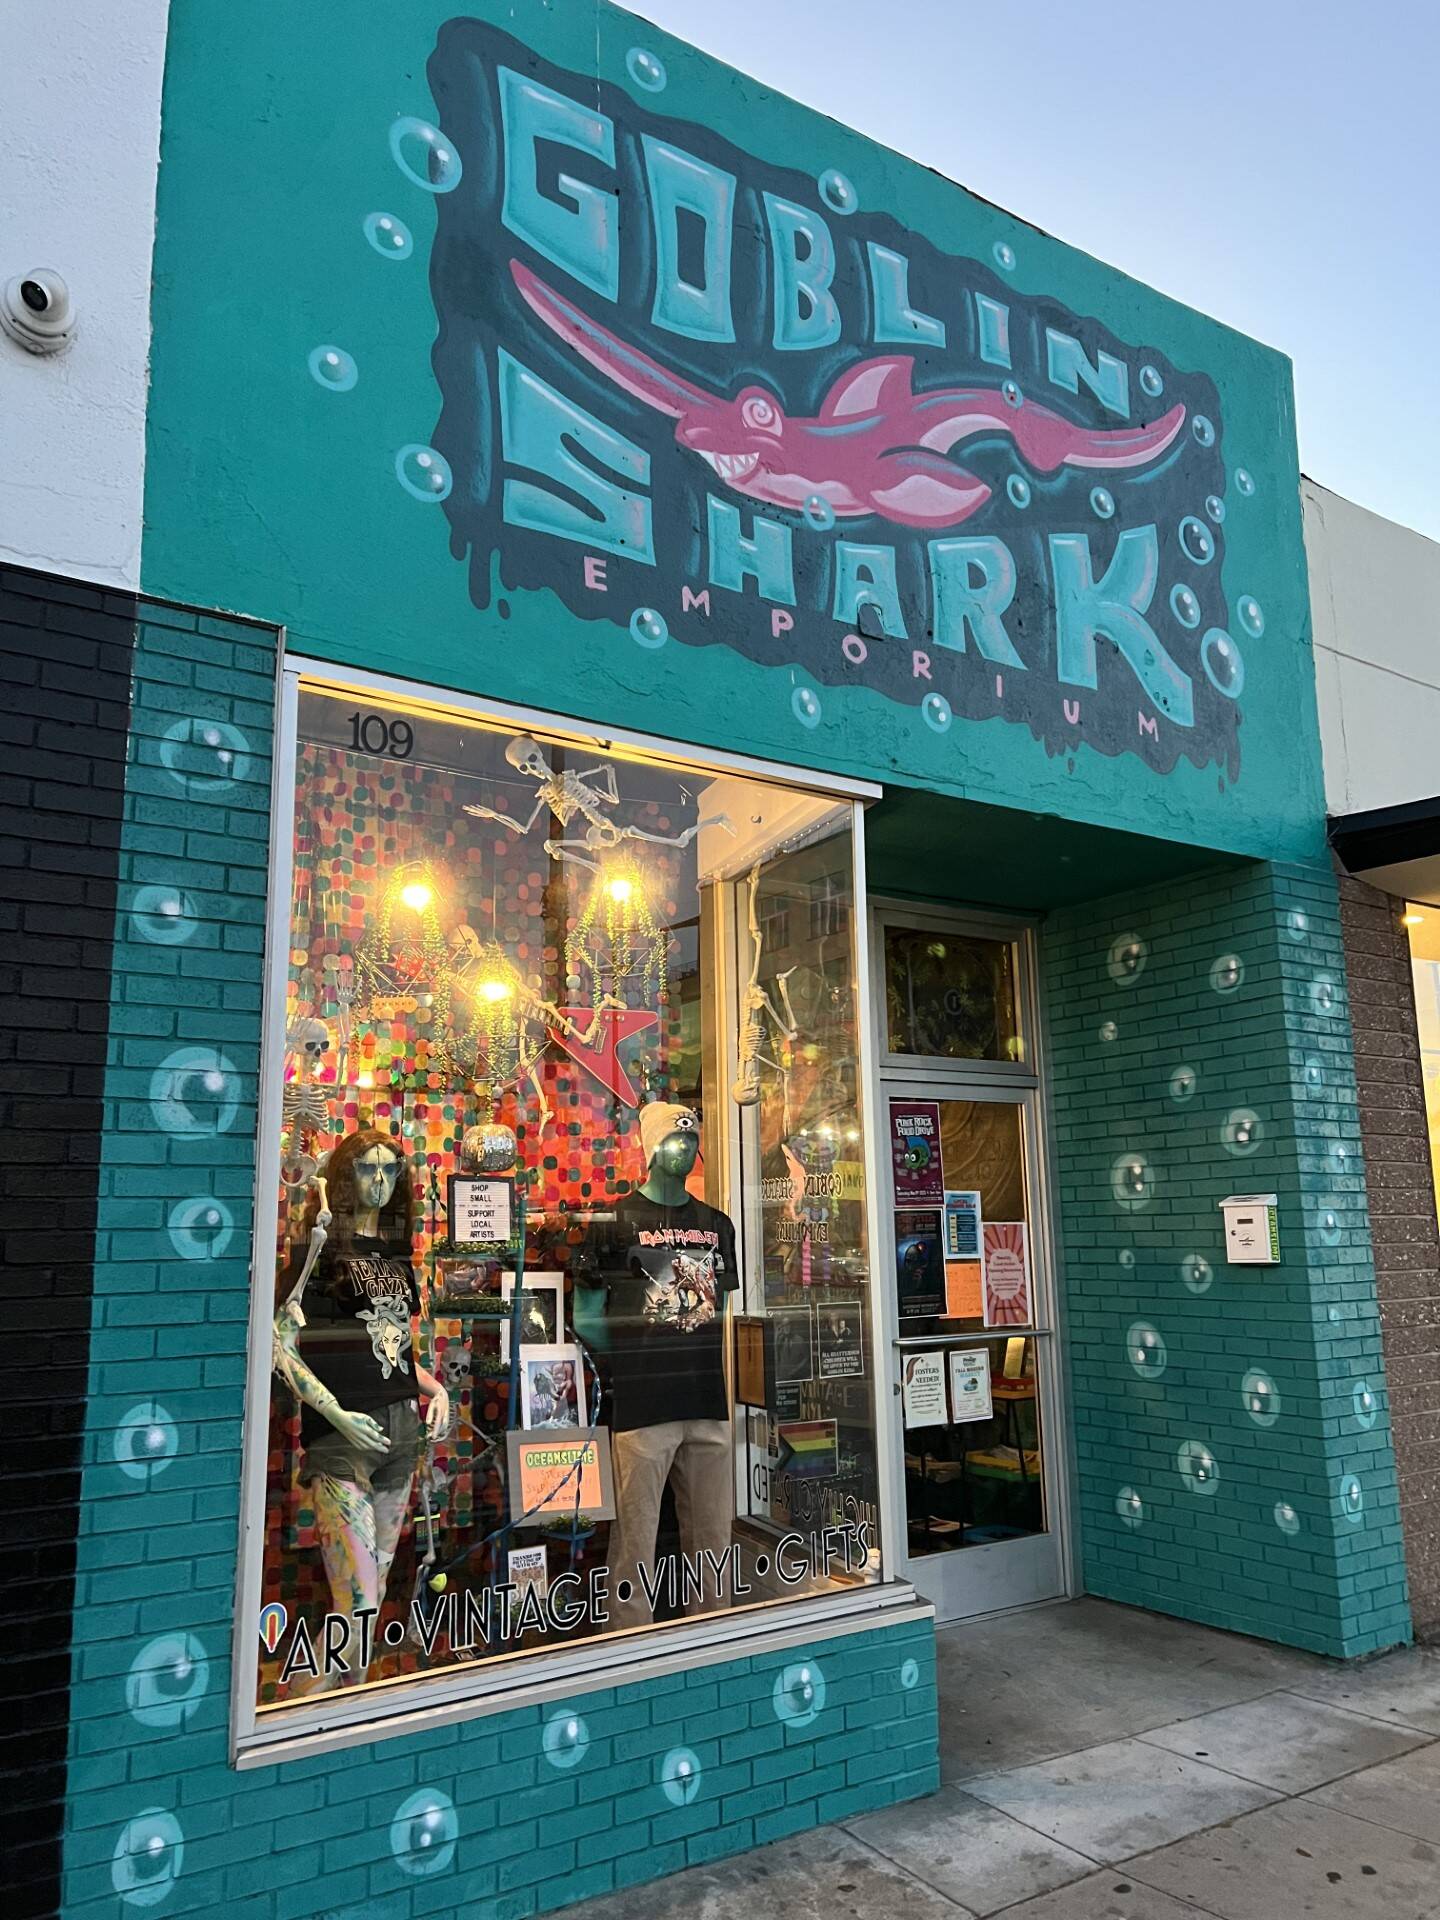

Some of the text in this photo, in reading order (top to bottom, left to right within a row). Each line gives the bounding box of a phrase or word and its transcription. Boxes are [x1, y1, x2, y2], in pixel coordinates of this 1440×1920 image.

[496, 64, 1132, 420] GOBLIN
[496, 346, 1195, 729] SHARK
[583, 556, 1162, 744] EMPORIUM
[347, 711, 414, 759] 109
[471, 1184, 489, 1192] SHOP
[470, 1194, 492, 1202] SMALL
[467, 1209, 495, 1218] SUPPORT
[470, 1220, 492, 1228] LOCAL
[469, 1230, 495, 1238] ARTISTS
[638, 1229, 719, 1249] IRON MAIDEN
[915, 1367, 939, 1375] FOSTERS
[278, 1519, 871, 1685] ART VINTAGE VINYL GIFTS
